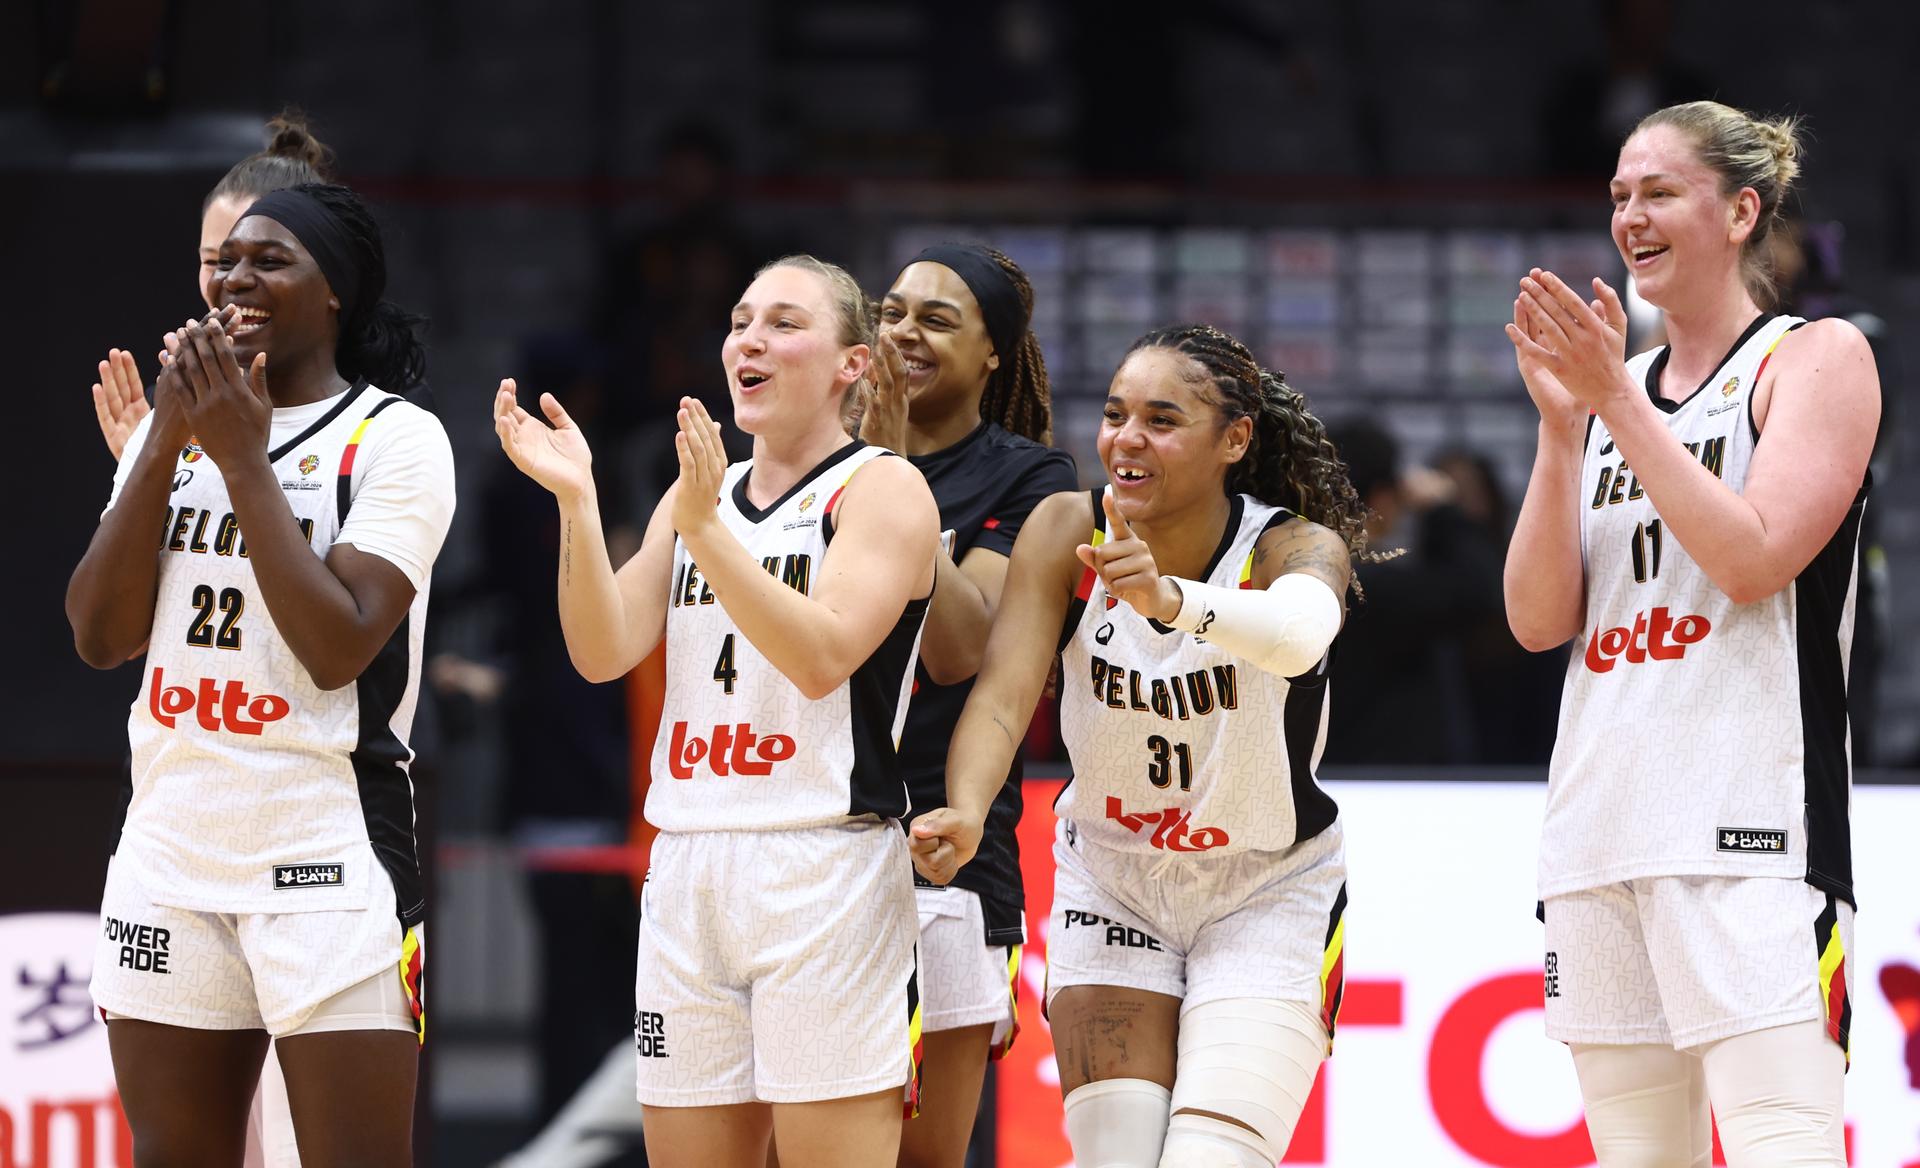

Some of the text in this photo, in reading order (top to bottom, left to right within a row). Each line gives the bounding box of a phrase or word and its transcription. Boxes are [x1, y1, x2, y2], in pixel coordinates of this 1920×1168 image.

[186, 584, 245, 651] 22
[713, 633, 737, 695] 4
[1091, 655, 1238, 721] BELGIUM
[1147, 735, 1193, 792] 31
[104, 916, 171, 950] POWER
